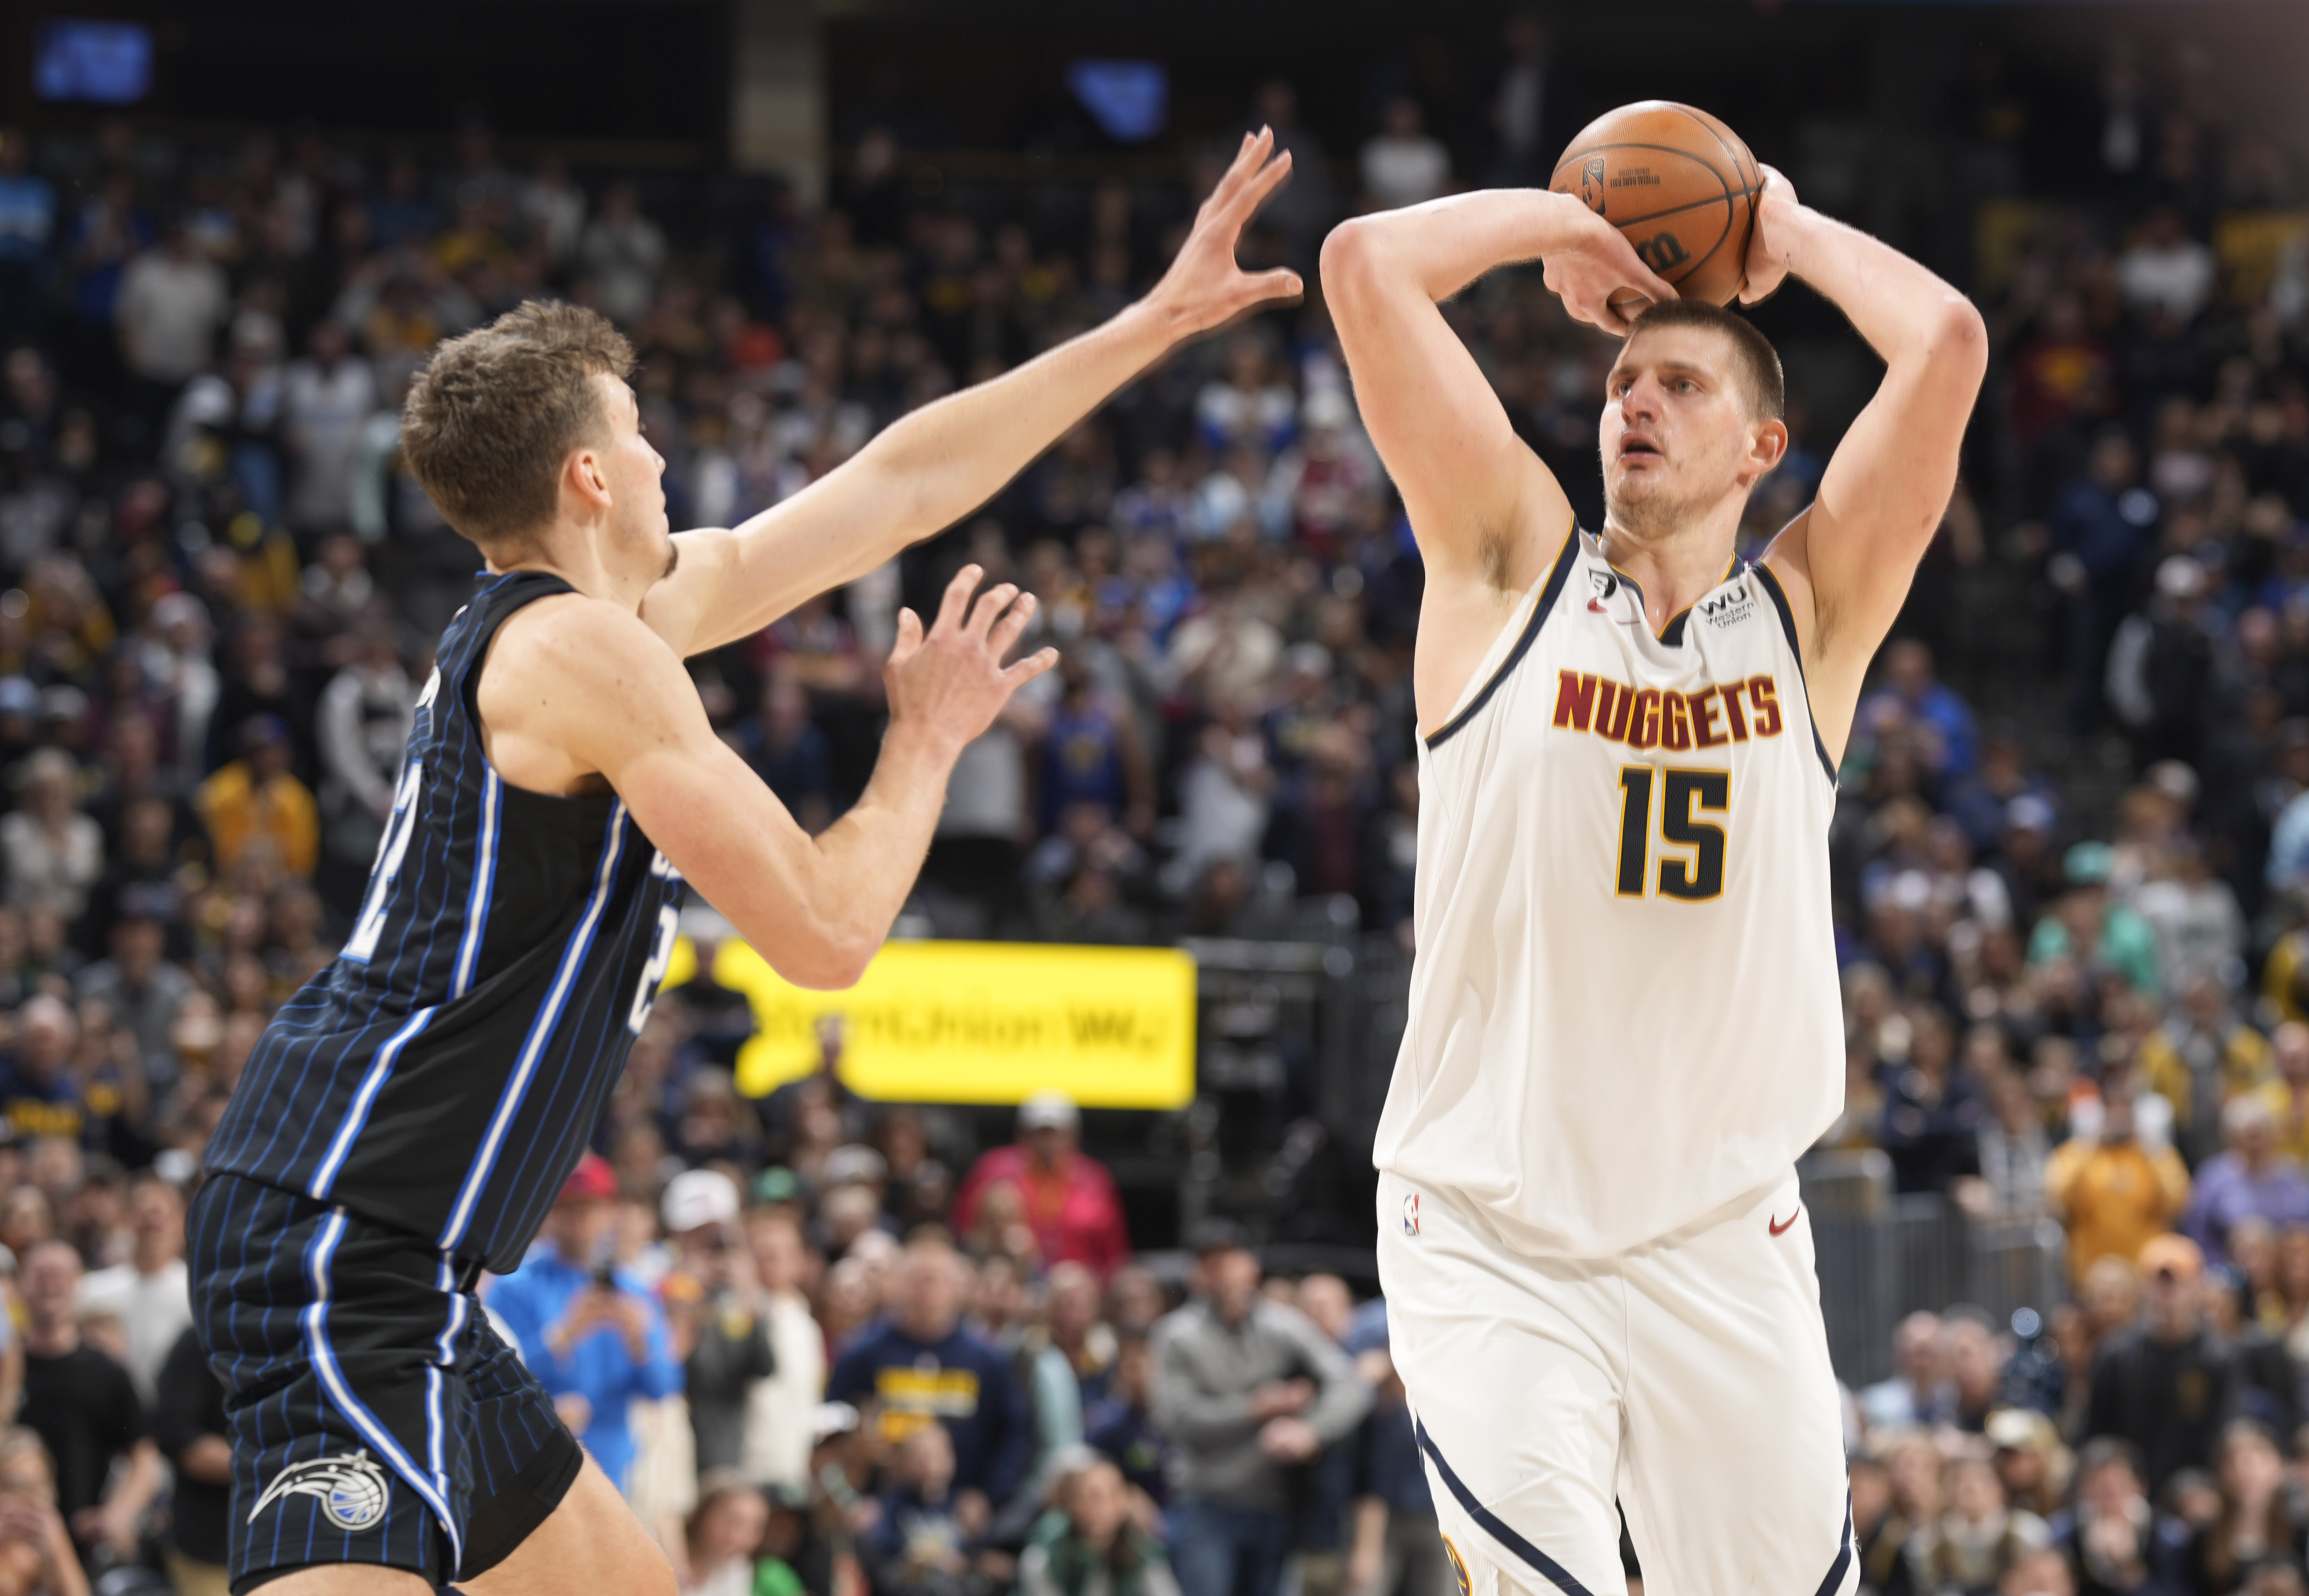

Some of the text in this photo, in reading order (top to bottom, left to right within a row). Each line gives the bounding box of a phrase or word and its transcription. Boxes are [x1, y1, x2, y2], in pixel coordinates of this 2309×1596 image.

[1698, 585, 1747, 616] WU
[1705, 602, 1754, 625] Western
[1718, 613, 1751, 629] Union
[1552, 669, 1783, 753] NUGGETS
[1615, 764, 1731, 903] 15
